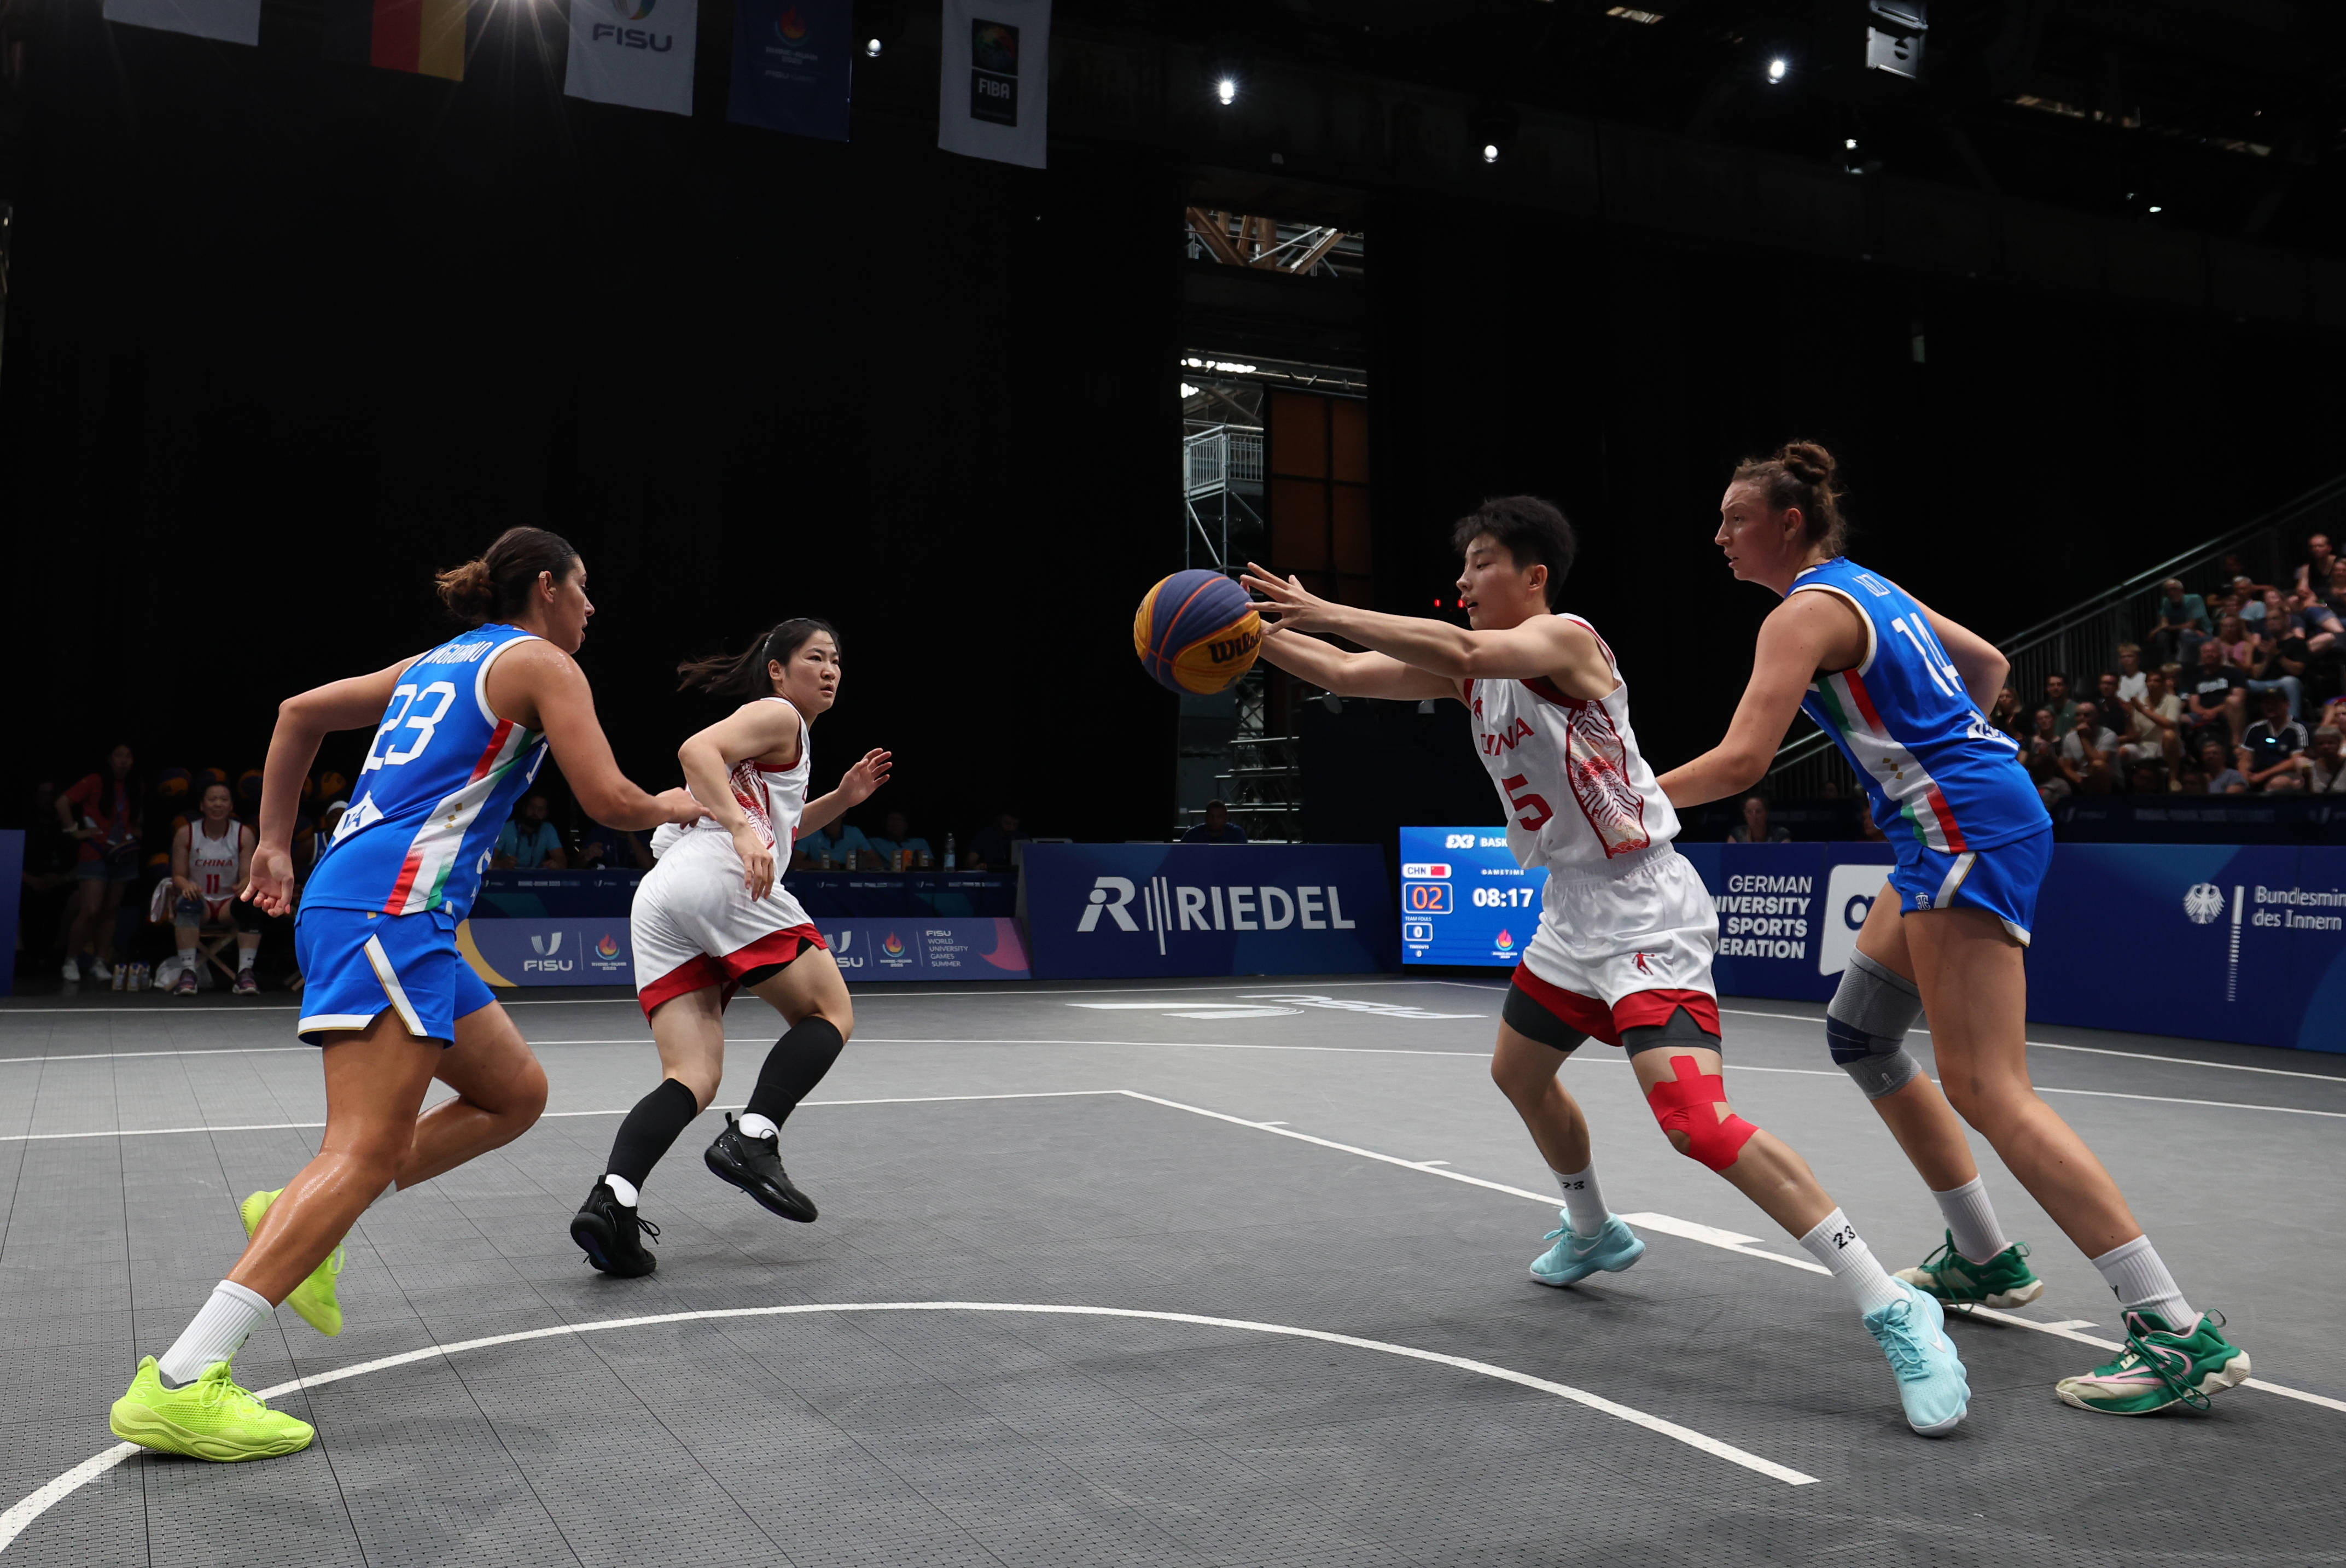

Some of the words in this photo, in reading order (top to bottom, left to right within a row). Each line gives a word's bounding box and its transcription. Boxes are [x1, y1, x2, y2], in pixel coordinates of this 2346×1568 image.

[592, 24, 672, 53] FISU
[979, 78, 1010, 99] FIBA
[1891, 613, 1963, 697] 14
[360, 681, 456, 775] 23
[1501, 773, 1553, 831] 5
[195, 859, 233, 867] CHINA
[206, 873, 220, 894] 11
[1728, 875, 1812, 894] GERMAN
[1412, 886, 1443, 910] 02
[1472, 888, 1534, 907] 08:17
[1177, 886, 1355, 931] RIEDEL
[2252, 908, 2281, 927] des
[2285, 909, 2342, 930] Innern
[1413, 926, 1423, 937] 0
[1727, 917, 1808, 937] SPORTS
[524, 960, 573, 971] FISU
[834, 957, 864, 967] SU
[1562, 1181, 1585, 1190] 23
[1833, 1225, 1856, 1250] 23
